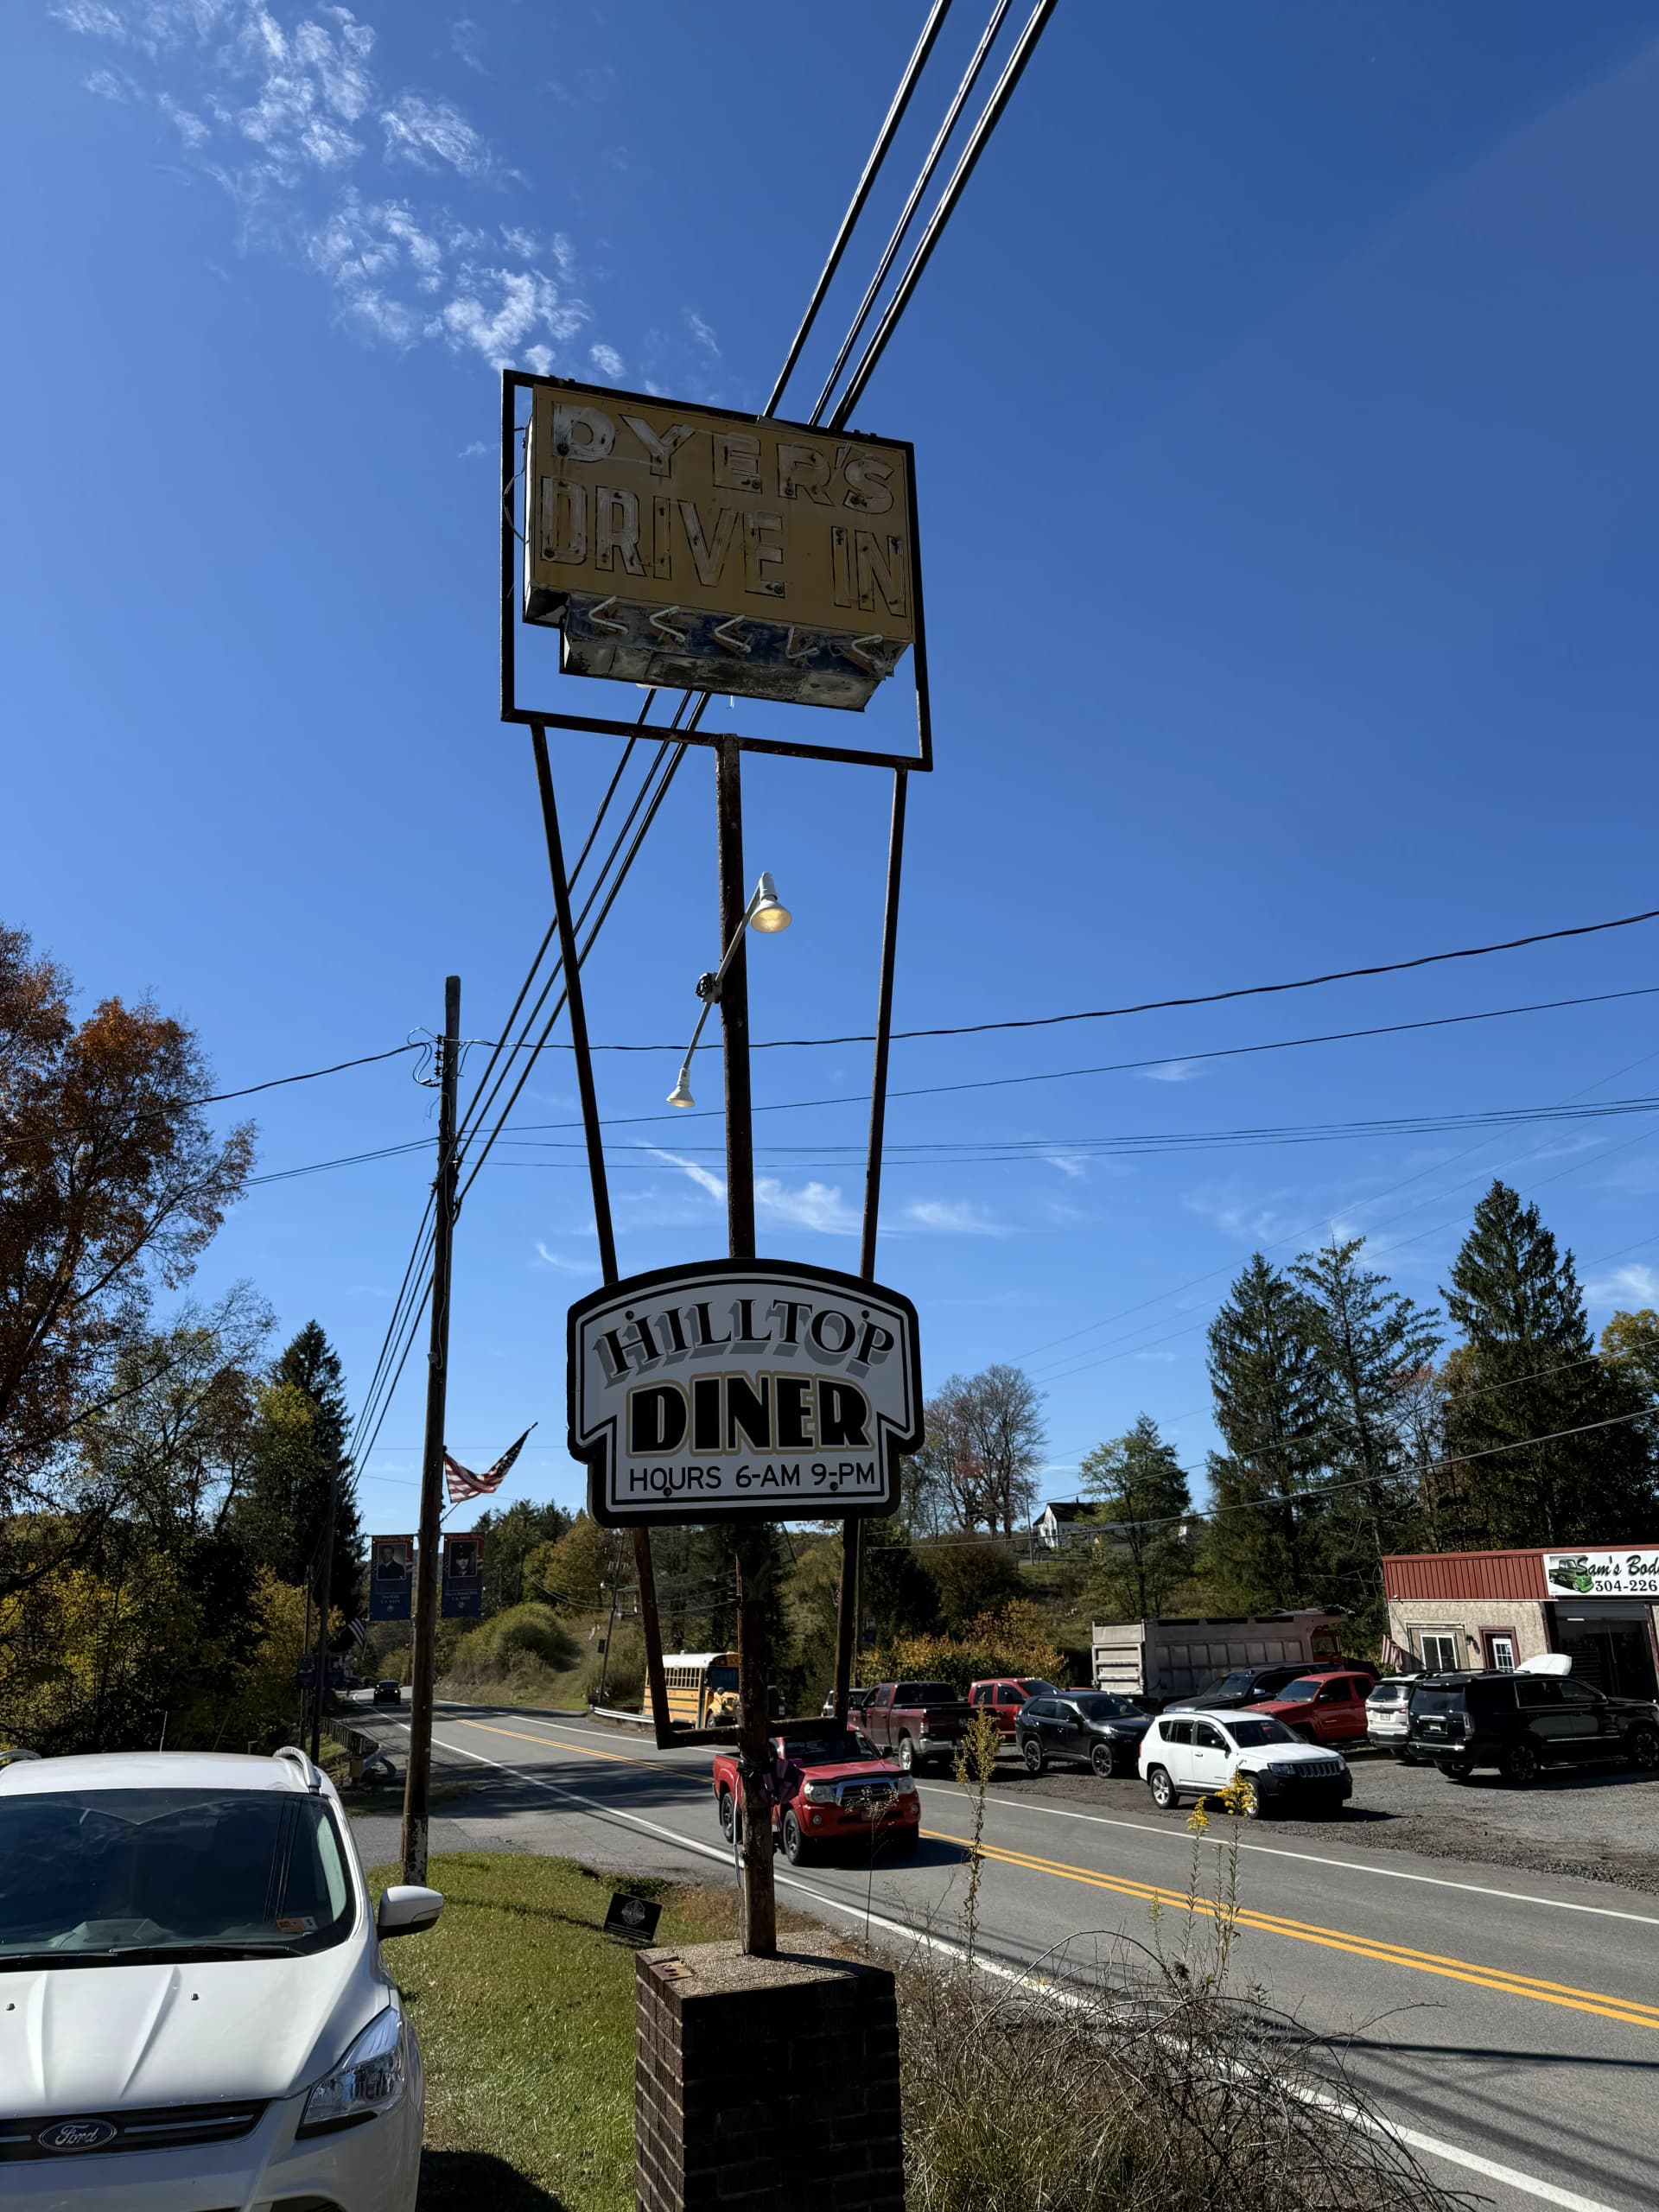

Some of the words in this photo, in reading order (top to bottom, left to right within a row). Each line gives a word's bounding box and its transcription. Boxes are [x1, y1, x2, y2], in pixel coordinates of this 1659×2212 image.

[551, 400, 895, 515] DYER'S
[540, 476, 786, 599] DRIVE
[830, 525, 907, 618] IN
[599, 1299, 895, 1378] HILLTOP
[629, 1373, 874, 1454] DINER
[629, 1466, 722, 1492] HOURS
[735, 1463, 801, 1487] 6-AM
[810, 1461, 875, 1485] 9-PM
[1576, 1555, 1622, 1576] Sam's
[1626, 1554, 1659, 1576] Bod
[1595, 1580, 1658, 1592] 304-226
[54, 2125, 99, 2145] Ford
